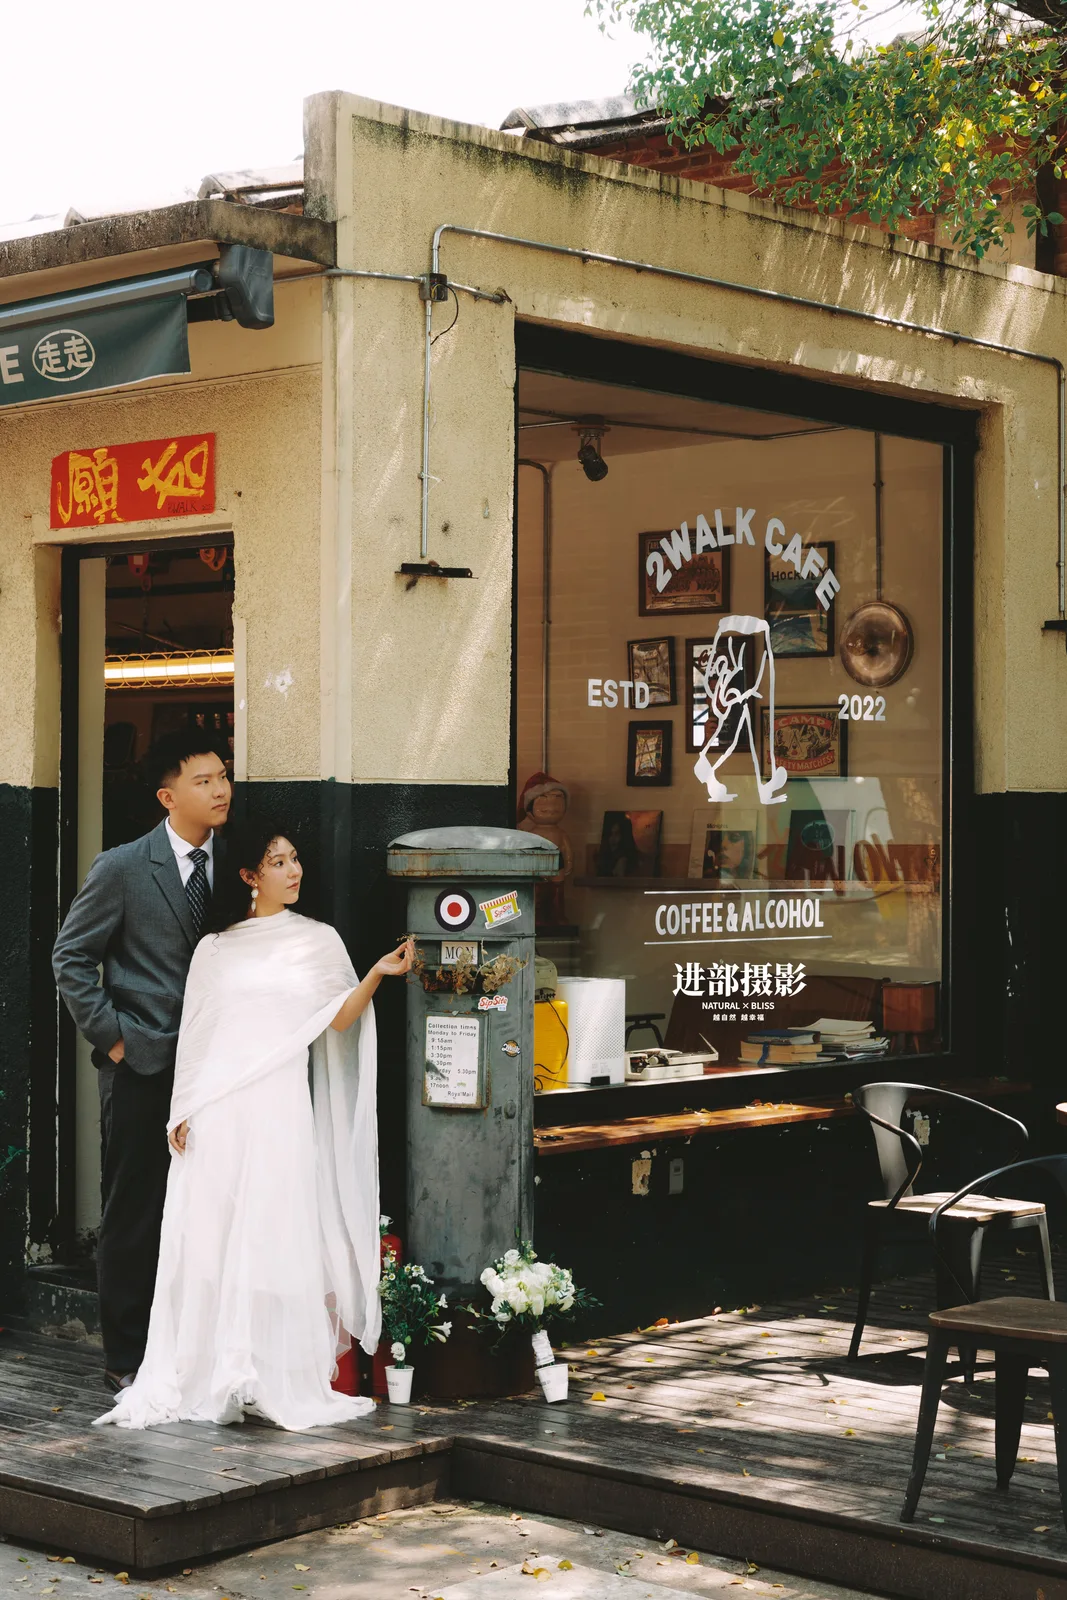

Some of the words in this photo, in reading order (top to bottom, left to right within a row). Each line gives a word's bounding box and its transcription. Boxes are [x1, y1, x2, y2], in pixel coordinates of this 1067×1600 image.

[38, 336, 93, 376] 走走
[646, 507, 756, 593] 2WALK
[765, 518, 841, 611] CAFE
[587, 678, 650, 709] ESTD
[837, 694, 886, 721] 2022
[778, 715, 825, 727] CAMP
[655, 902, 723, 935] COFFEE
[741, 898, 824, 932] ALCOHOL
[428, 1022, 458, 1030] Collection
